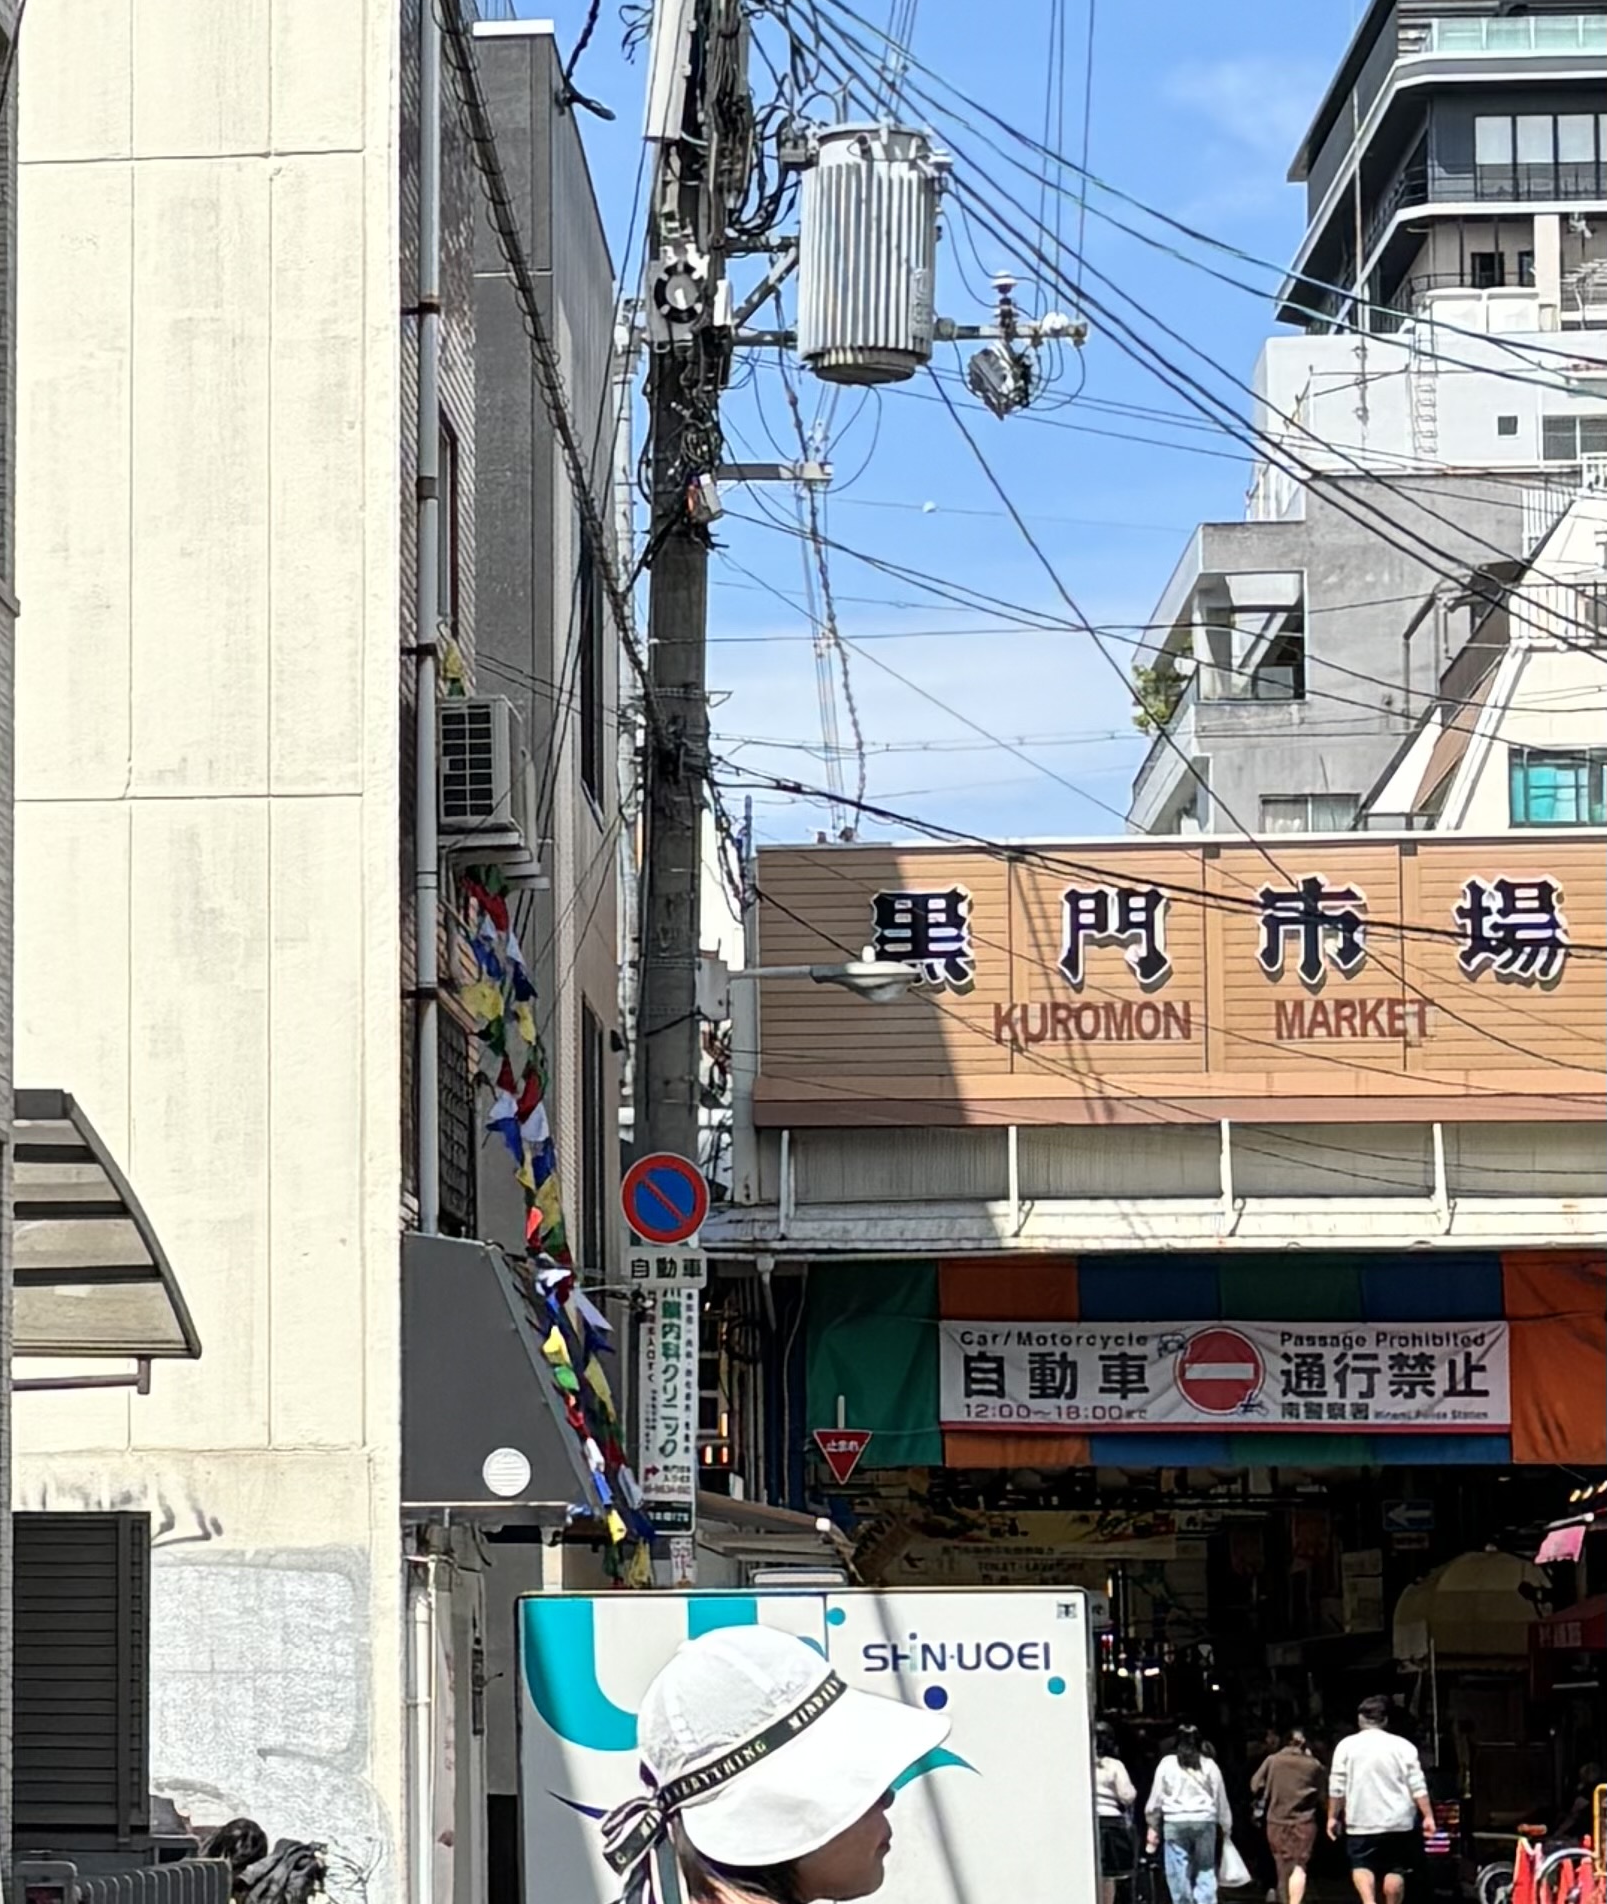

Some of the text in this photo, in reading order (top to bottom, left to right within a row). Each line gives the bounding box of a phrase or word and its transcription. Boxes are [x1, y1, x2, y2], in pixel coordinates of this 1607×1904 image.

[871, 875, 1570, 991] 黒門市場
[994, 997, 1432, 1045] KUROMON MARKET
[631, 1256, 703, 1279] 自動車
[960, 1330, 1148, 1347] Car/Motorcycle
[1280, 1330, 1486, 1350] Passage Prohibited
[963, 1350, 1150, 1400] 自動車
[1280, 1351, 1490, 1399] 通行禁止
[825, 1439, 860, 1454] 止まれ
